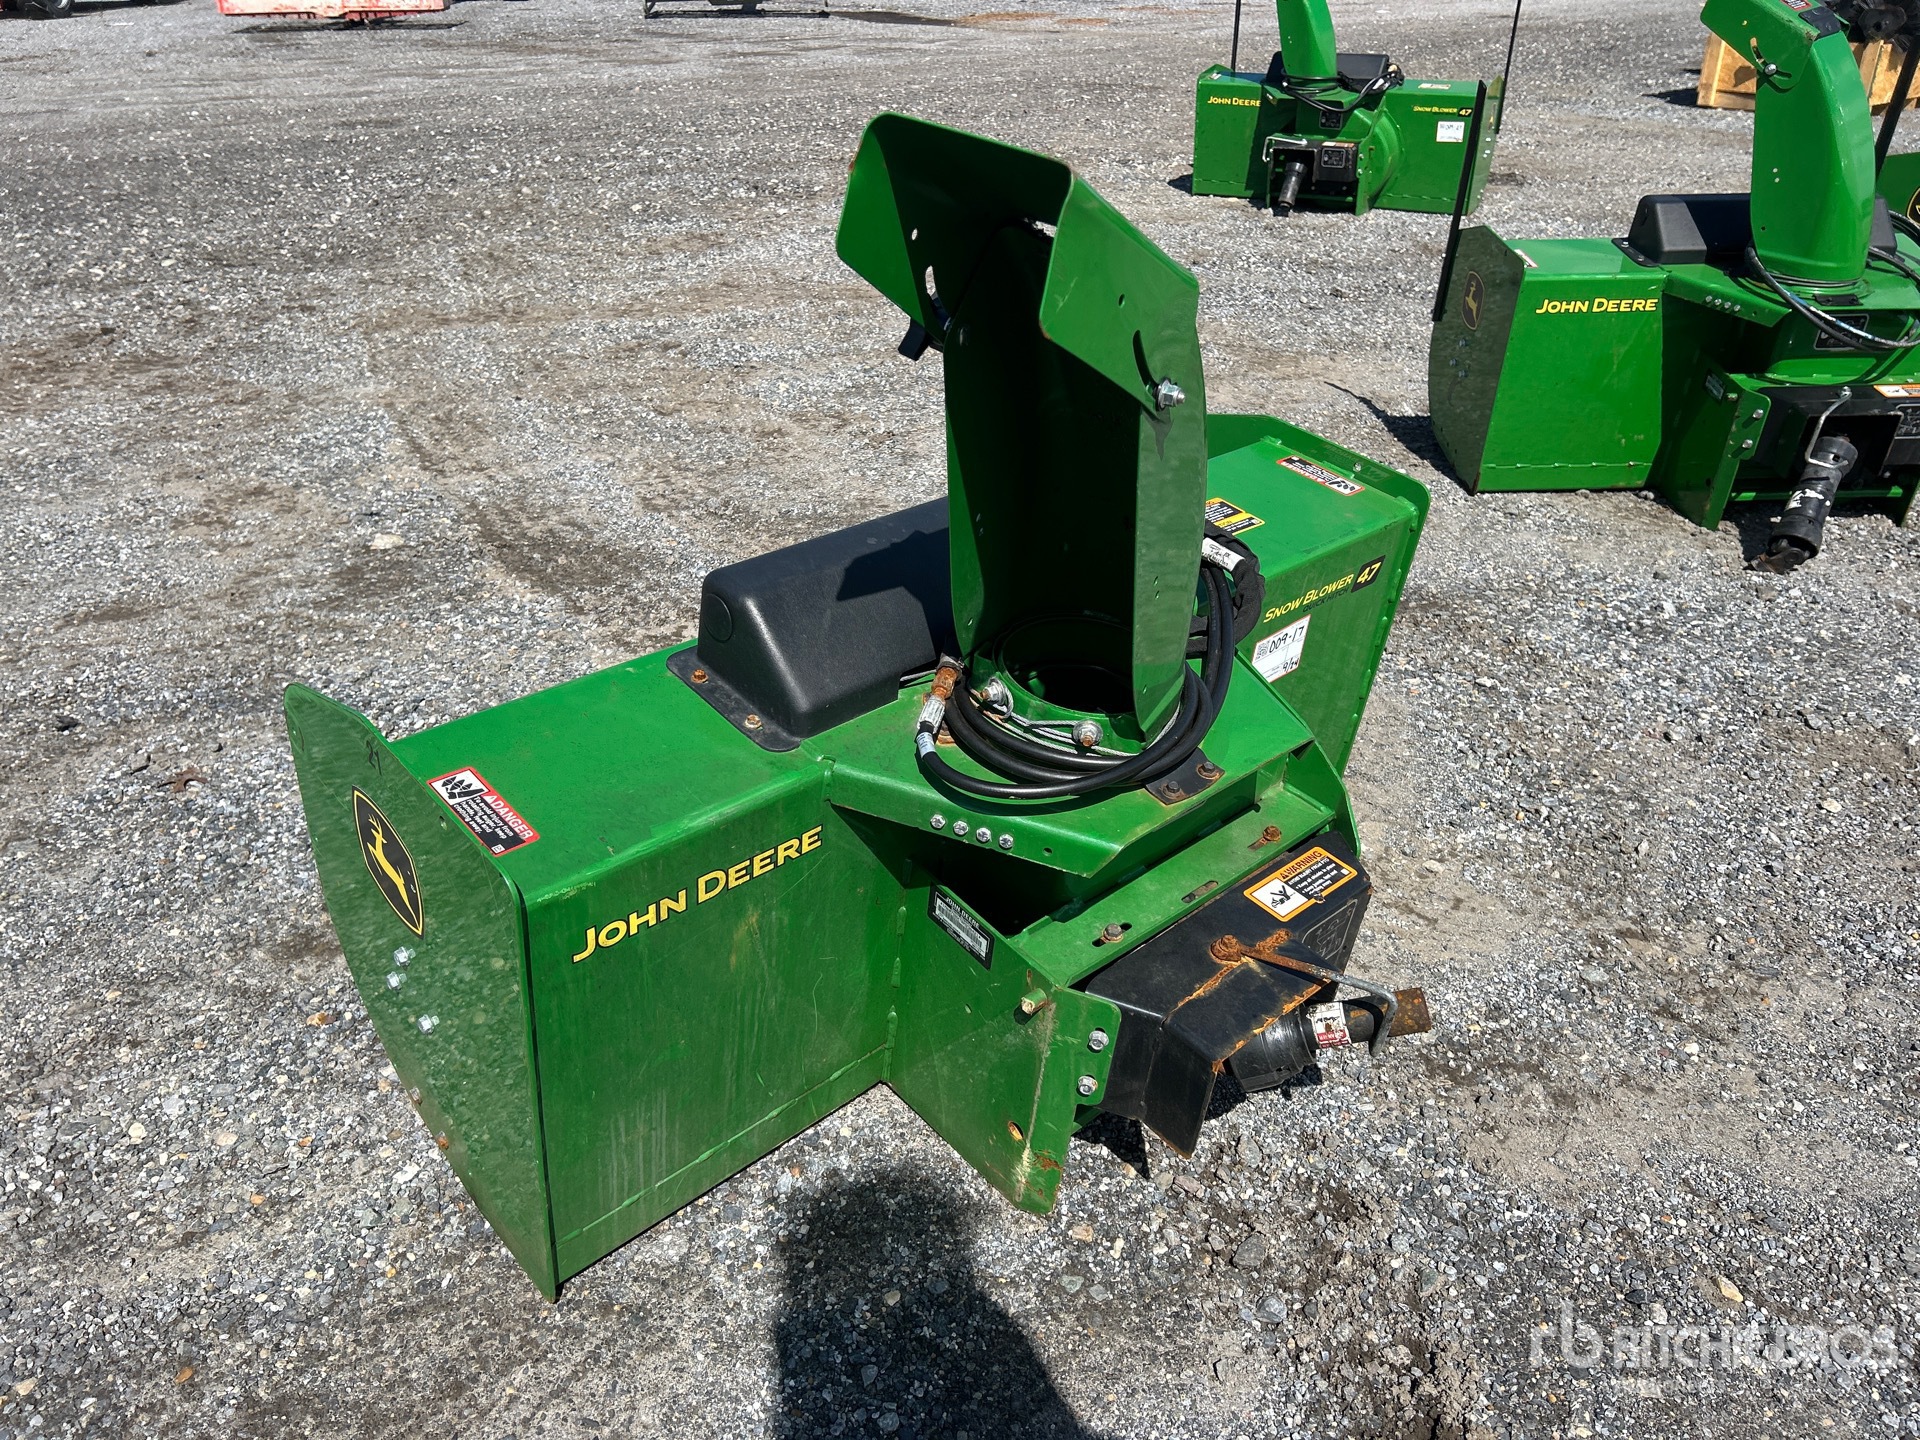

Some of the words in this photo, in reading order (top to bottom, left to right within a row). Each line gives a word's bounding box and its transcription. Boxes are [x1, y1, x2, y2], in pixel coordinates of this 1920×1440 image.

[1208, 96, 1231, 104] JOHN
[1232, 97, 1261, 106] DEERE
[1536, 298, 1588, 314] JOHN
[1592, 298, 1658, 312] DEERE
[1263, 596, 1305, 623] SNOW
[1303, 574, 1354, 606] BLOWER
[1356, 562, 1382, 584] 47
[1303, 597, 1325, 612] QUICK
[490, 800, 534, 840] DANGER
[1284, 850, 1323, 876] WARNING
[572, 888, 687, 964] JOHN
[697, 824, 823, 905] DEERE
